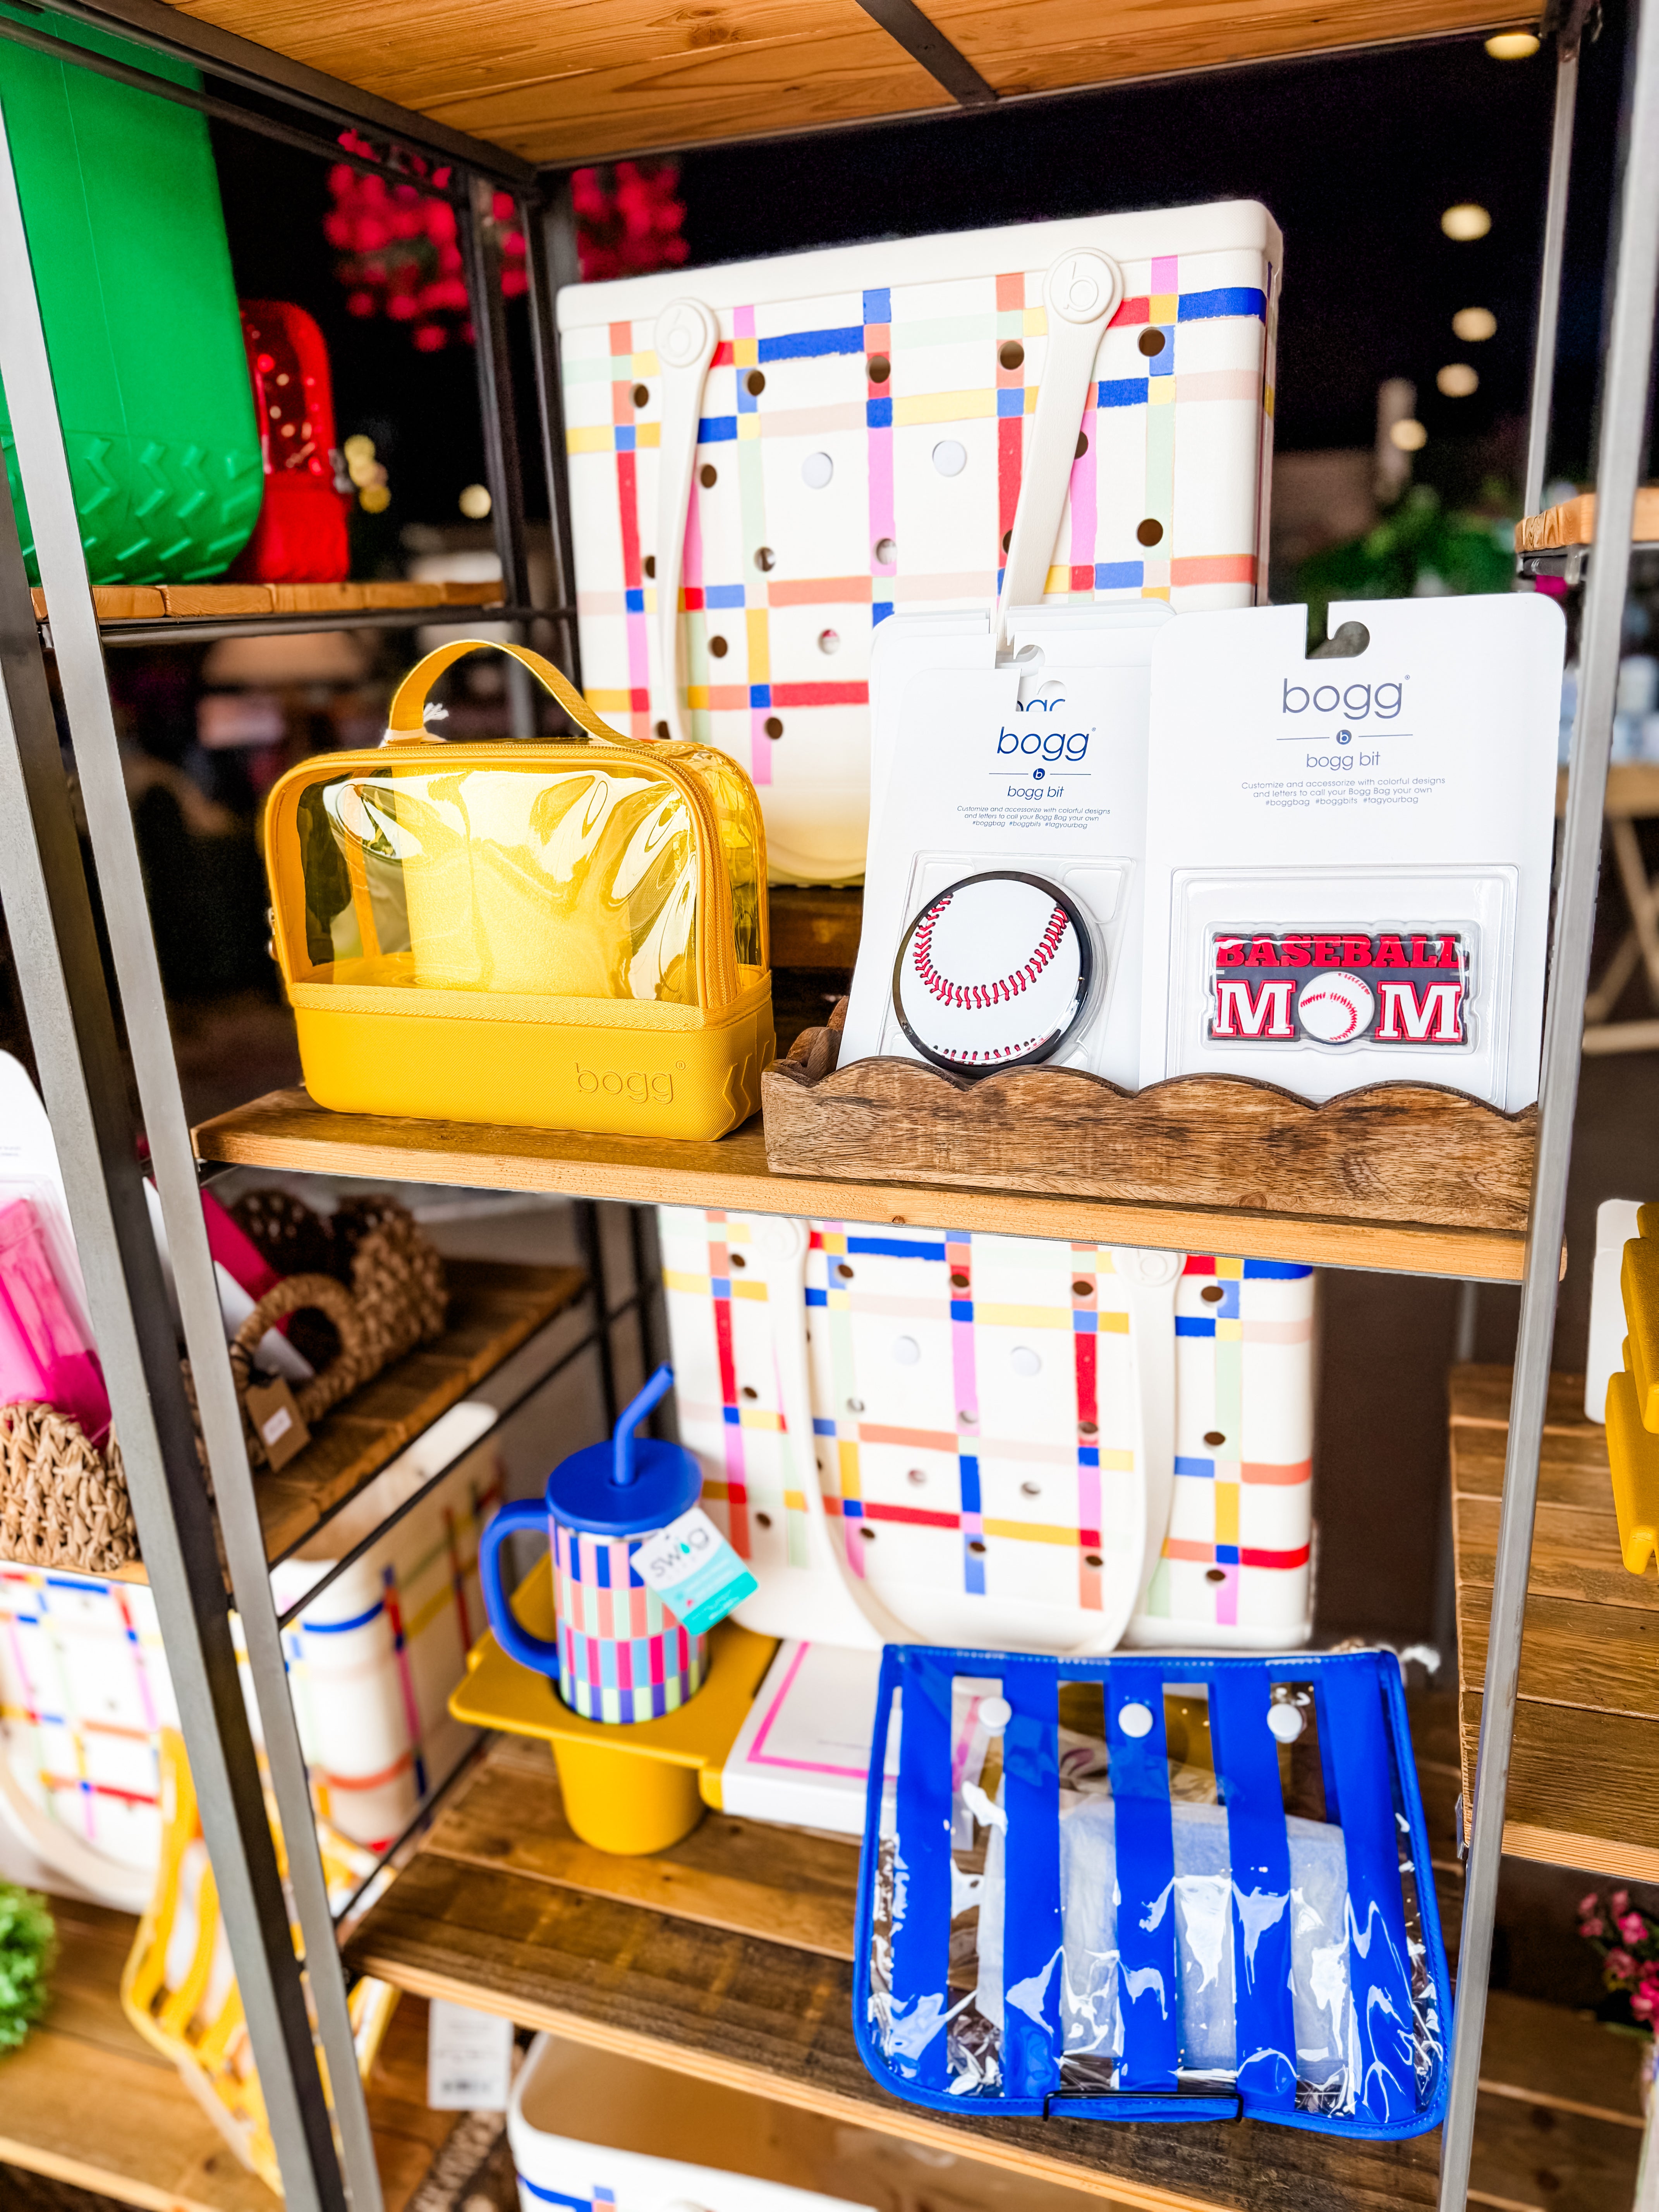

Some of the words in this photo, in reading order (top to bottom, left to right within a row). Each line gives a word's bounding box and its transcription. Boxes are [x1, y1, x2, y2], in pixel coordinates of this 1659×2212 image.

[1306, 754, 1353, 771] bogg
[1360, 751, 1381, 766] bit
[1412, 777, 1446, 785] designs
[1007, 785, 1044, 800] bogg
[1047, 786, 1065, 797] bit
[1348, 788, 1370, 796] Bogg
[1374, 787, 1390, 795] Bag
[1266, 799, 1310, 807] #boggbag
[1316, 797, 1357, 806] #boggbits
[1363, 796, 1418, 805] #tagyourbag
[1215, 936, 1466, 968] BASEBALL
